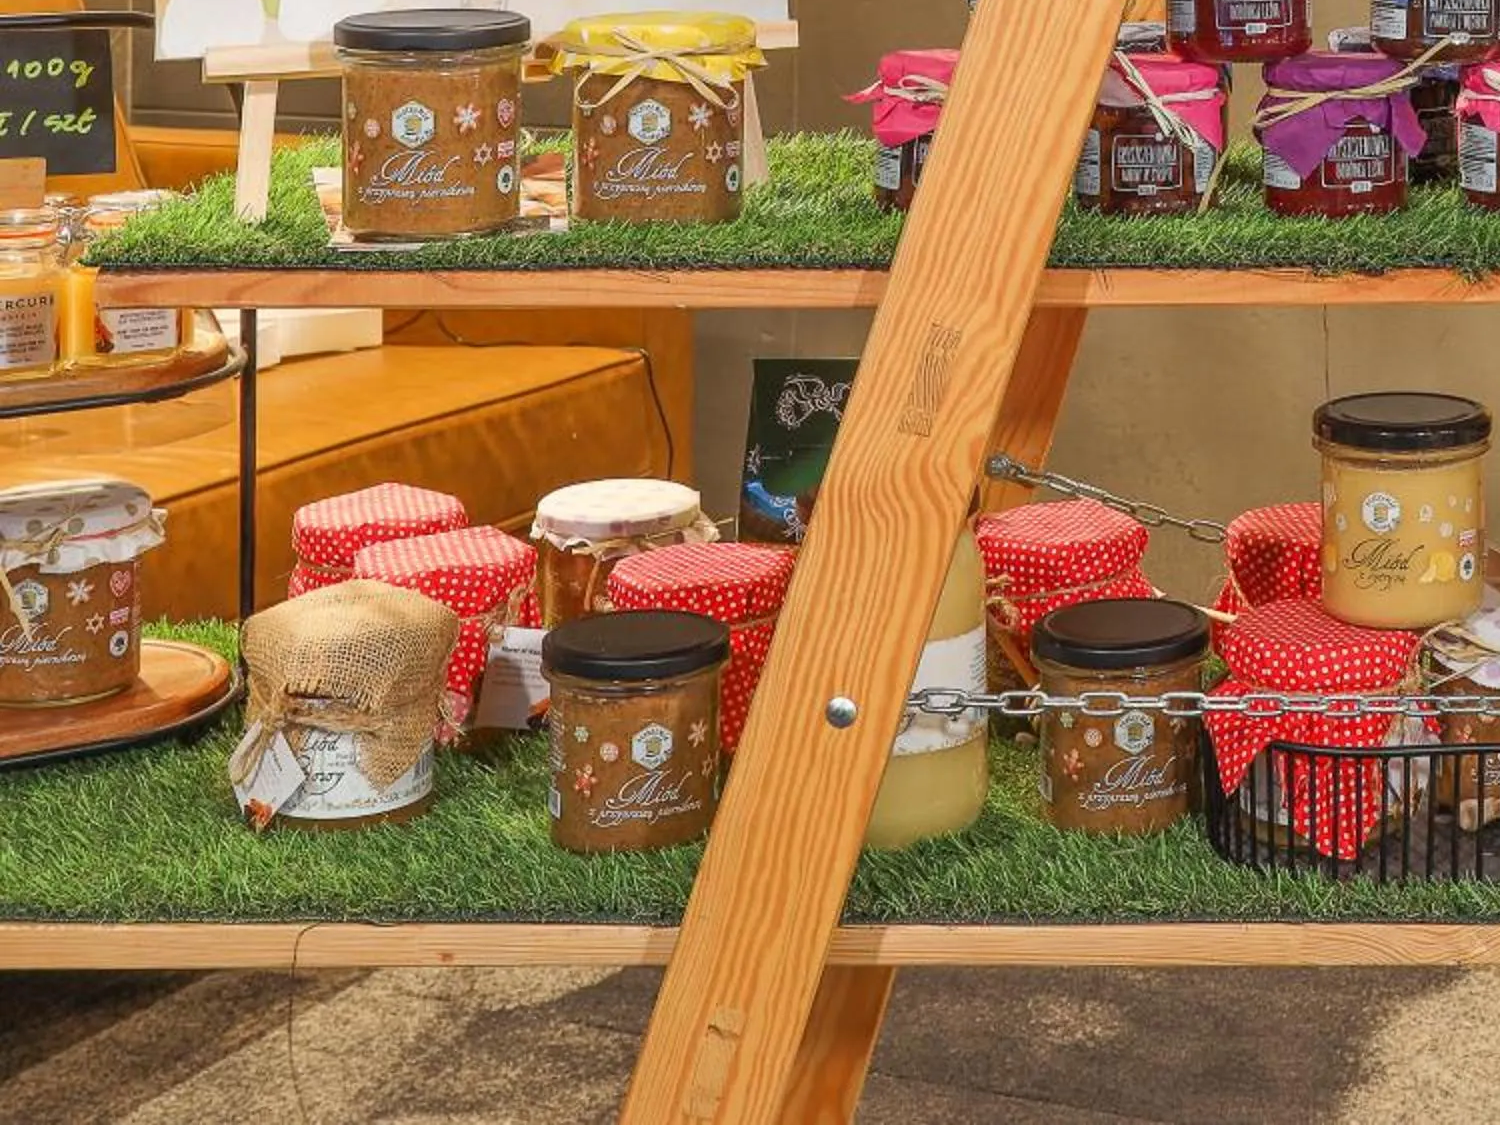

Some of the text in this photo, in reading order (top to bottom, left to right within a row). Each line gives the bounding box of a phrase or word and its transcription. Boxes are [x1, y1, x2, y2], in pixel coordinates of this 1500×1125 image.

[370, 149, 461, 186] Miód
[605, 147, 695, 181] Miód
[0, 292, 54, 313] RCUR
[1343, 538, 1425, 572] Miód
[606, 768, 693, 809] Miód
[1094, 755, 1177, 793] Miód
